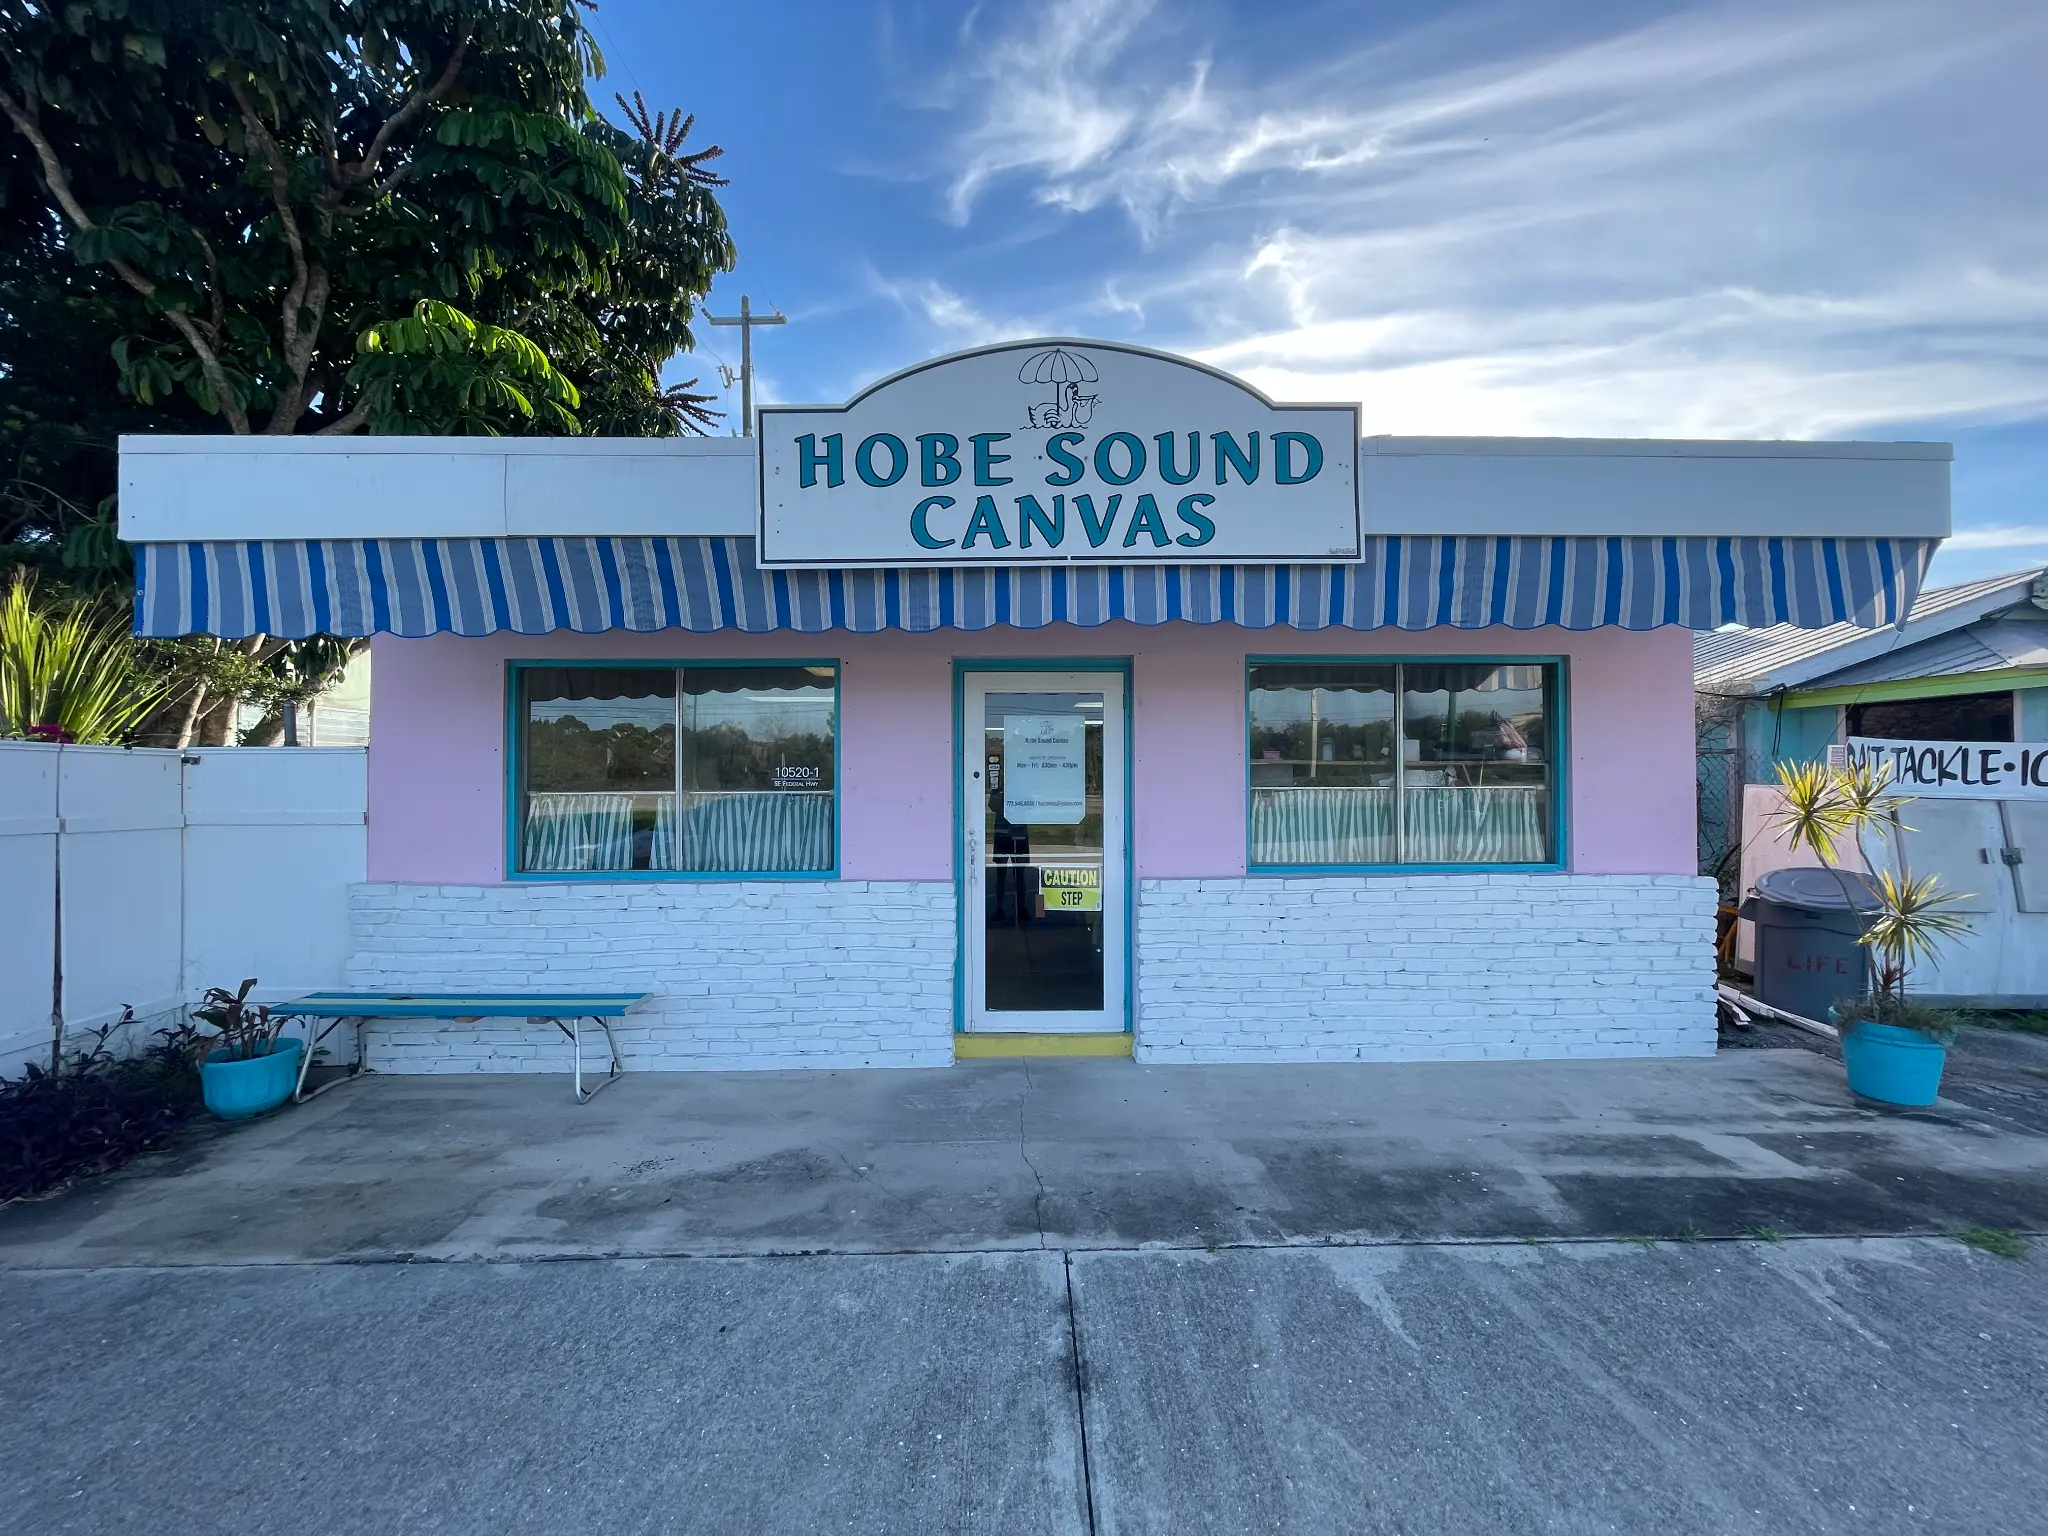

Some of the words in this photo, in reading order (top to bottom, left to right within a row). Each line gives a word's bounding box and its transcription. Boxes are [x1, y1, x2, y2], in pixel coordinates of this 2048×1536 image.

[793, 431, 1014, 488] HOBE
[1045, 430, 1325, 486] SOUND
[910, 492, 1216, 550] CANVAS
[774, 766, 819, 778] 10520-1
[1043, 869, 1097, 886] CAUTION
[1061, 891, 1083, 906] STEP
[1787, 953, 1849, 975] LIFE
